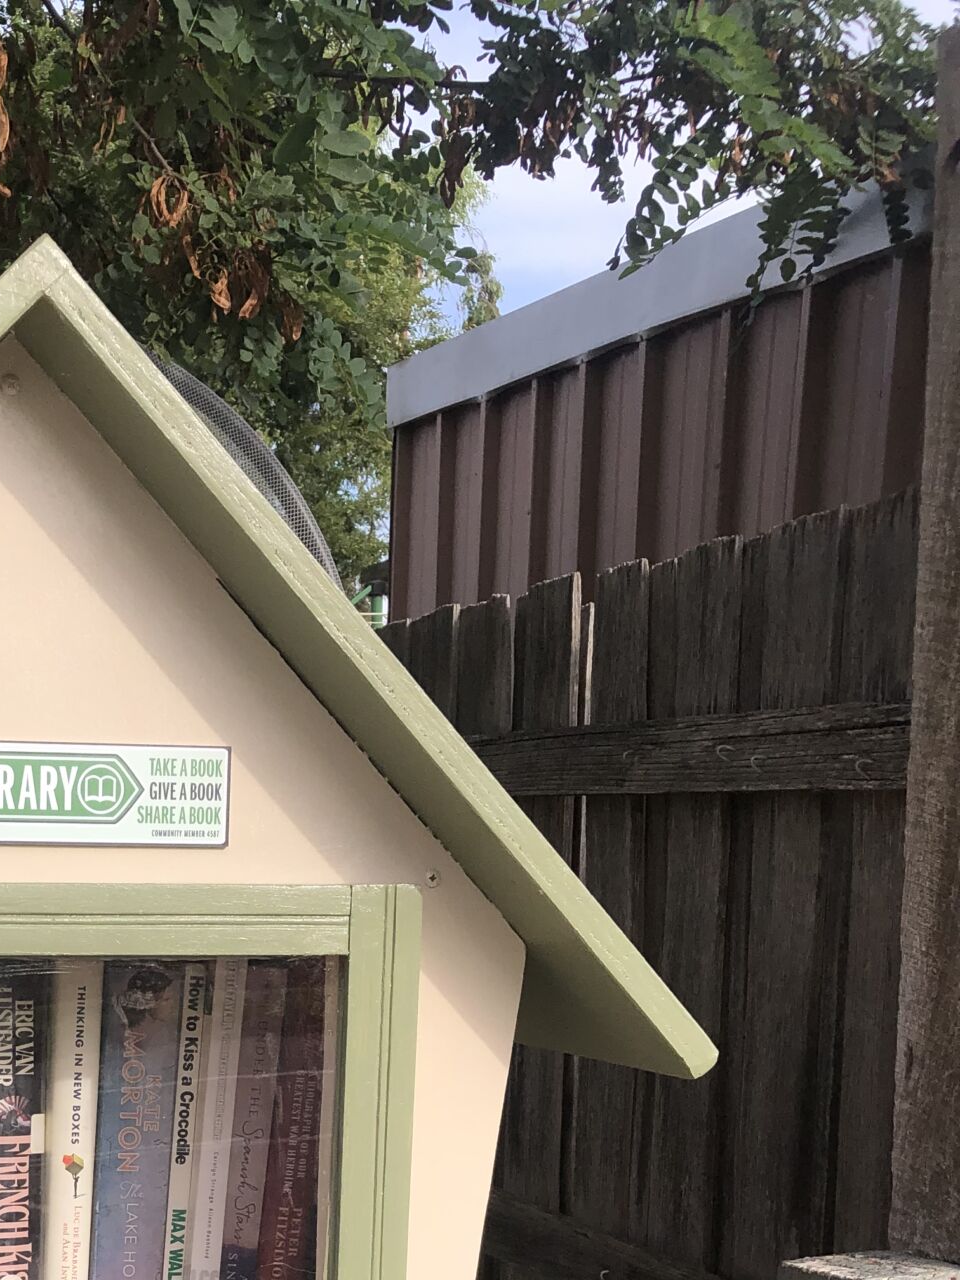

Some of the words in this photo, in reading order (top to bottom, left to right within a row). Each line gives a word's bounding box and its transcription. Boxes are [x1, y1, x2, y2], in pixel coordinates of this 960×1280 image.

[149, 758, 177, 776] TAKE
[180, 758, 188, 776] A
[190, 758, 223, 777] BOOK
[149, 782, 177, 800] GIVE
[179, 782, 187, 800] A
[190, 783, 222, 801] BOOK
[137, 805, 176, 824] SHARE
[178, 806, 186, 824] A
[189, 806, 221, 824] BOOK
[151, 829, 182, 838] COMMUNITY
[184, 830, 205, 838] MEMBER
[188, 976, 204, 1012] How
[14, 1000, 34, 1039] ERIC
[74, 986, 86, 1048] THINKING
[185, 1016, 201, 1032] to
[14, 1042, 35, 1076] VAN
[74, 1053, 83, 1067] IN
[182, 1037, 199, 1072] Kiss
[252, 1021, 268, 1078] UNDER
[73, 1072, 83, 1100] NEW
[181, 1076, 192, 1086] a
[117, 1031, 145, 1172] MORTON
[143, 1075, 162, 1132] KATE
[248, 1086, 262, 1117] THE
[71, 1105, 81, 1145] BOXES
[175, 1090, 195, 1165] Crocodile
[235, 1121, 264, 1195] Spanish
[120, 1182, 144, 1200] The
[124, 1203, 140, 1245] LAKE
[170, 1209, 187, 1244] MAX
[234, 1196, 256, 1243] Stars
[288, 1207, 304, 1257] PETER
